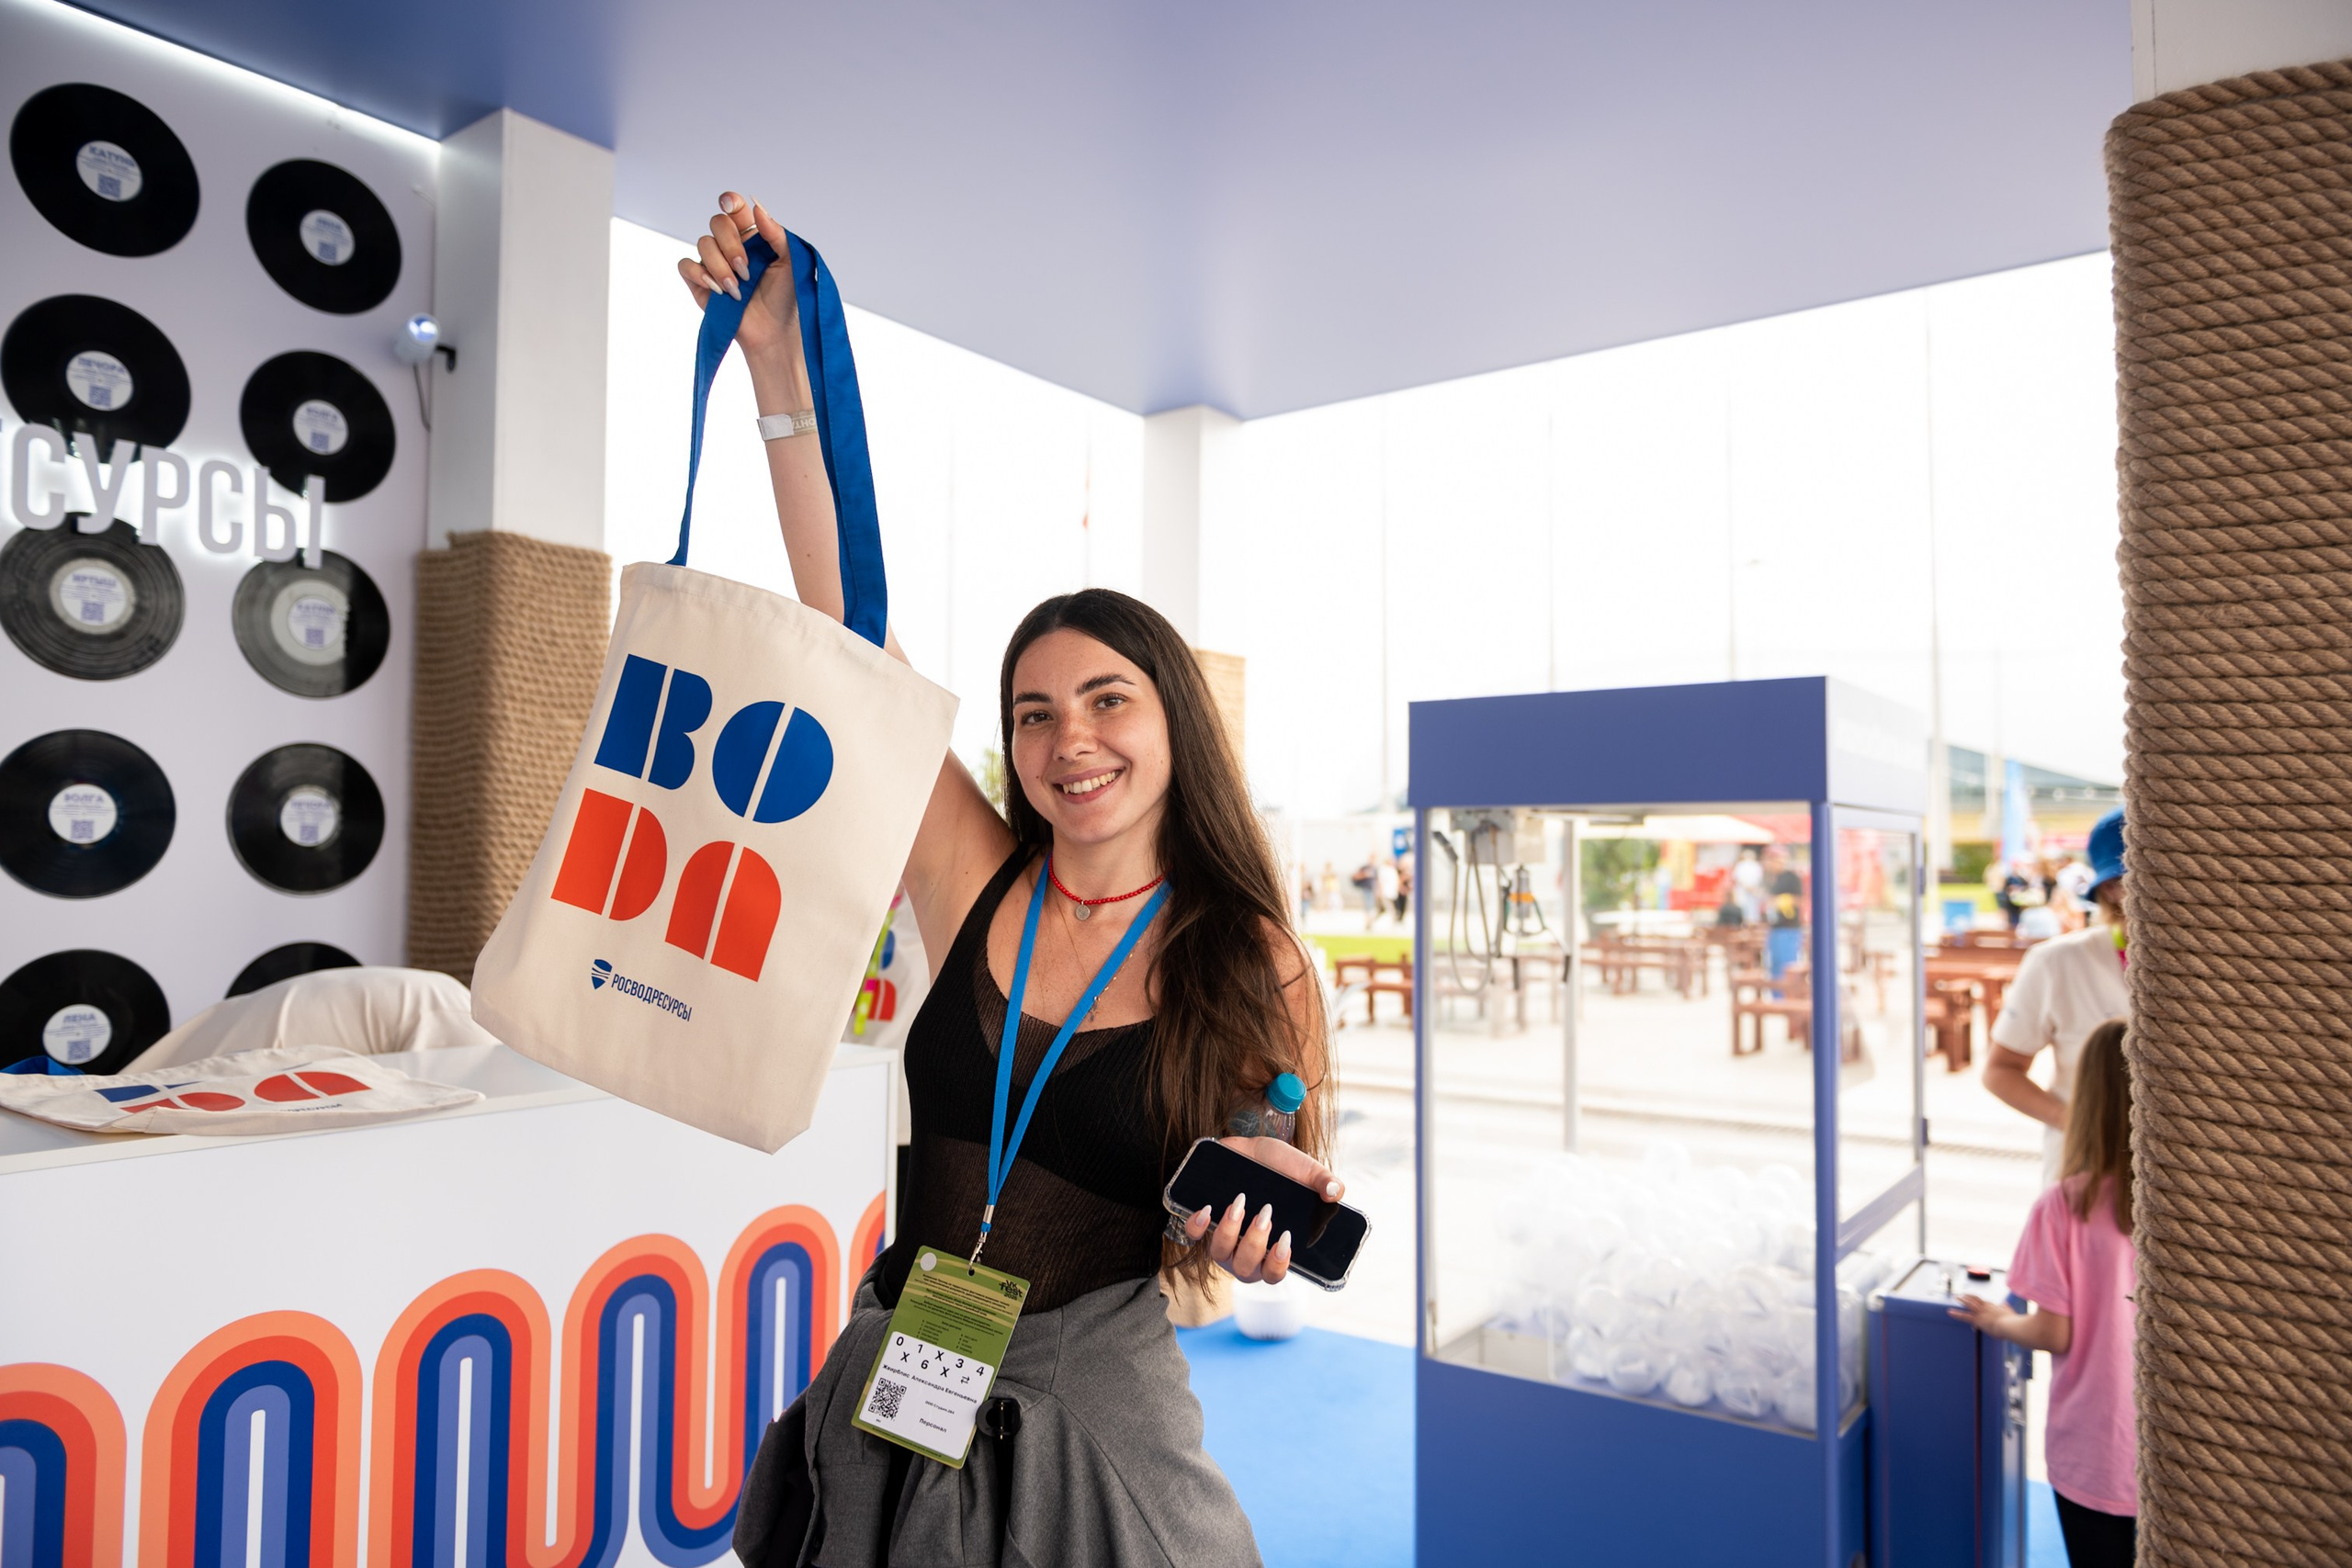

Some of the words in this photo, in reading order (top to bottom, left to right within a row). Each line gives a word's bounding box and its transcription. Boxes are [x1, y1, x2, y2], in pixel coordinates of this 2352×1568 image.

[0, 420, 325, 569] СУРСЫ
[594, 653, 834, 824] ВО
[64, 793, 104, 803] ВОЛГА
[611, 973, 693, 1021] РОСВОДРЕСУРСЫ
[896, 1336, 904, 1346] 0
[918, 1344, 923, 1354] 1
[956, 1359, 964, 1369] 3
[976, 1366, 985, 1376] 4
[921, 1359, 930, 1370] 6
[911, 1375, 944, 1392] Александра
[944, 1387, 978, 1404] Евгеньевна
[919, 1417, 947, 1433] Персонал
